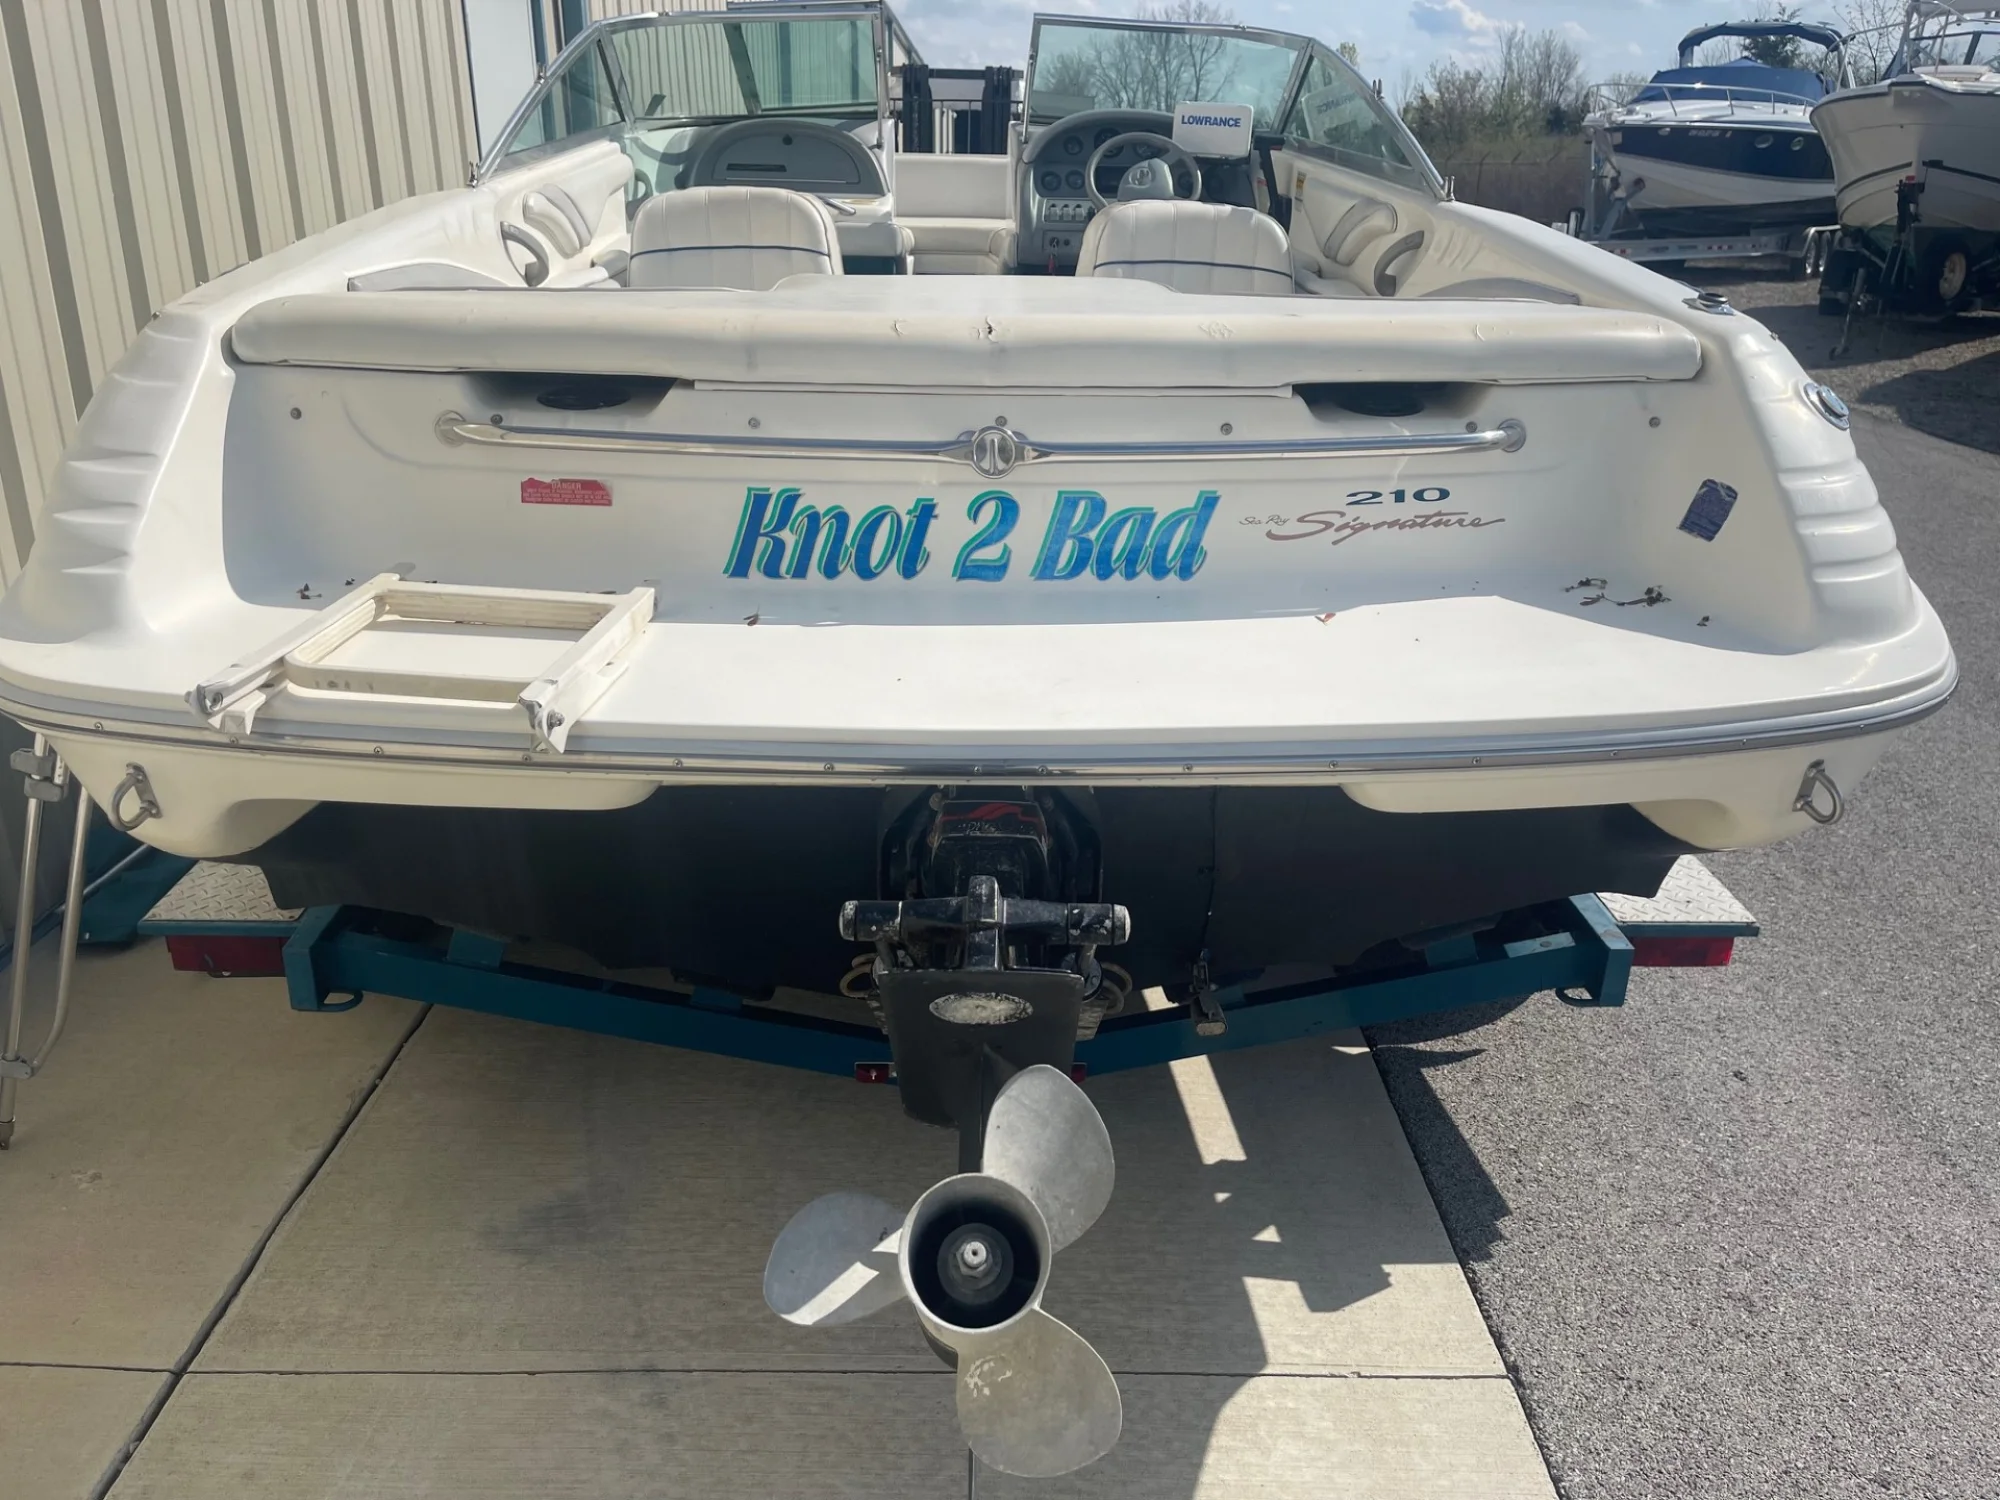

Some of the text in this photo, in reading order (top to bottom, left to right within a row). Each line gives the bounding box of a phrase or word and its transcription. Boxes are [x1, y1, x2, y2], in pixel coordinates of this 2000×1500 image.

[1181, 115, 1242, 128] LOWRANCE
[552, 481, 581, 490] DANGER
[1346, 487, 1451, 506] 210
[723, 487, 1222, 582] Knot 2 Bad
[1239, 510, 1506, 546] Sea Ray Signature
